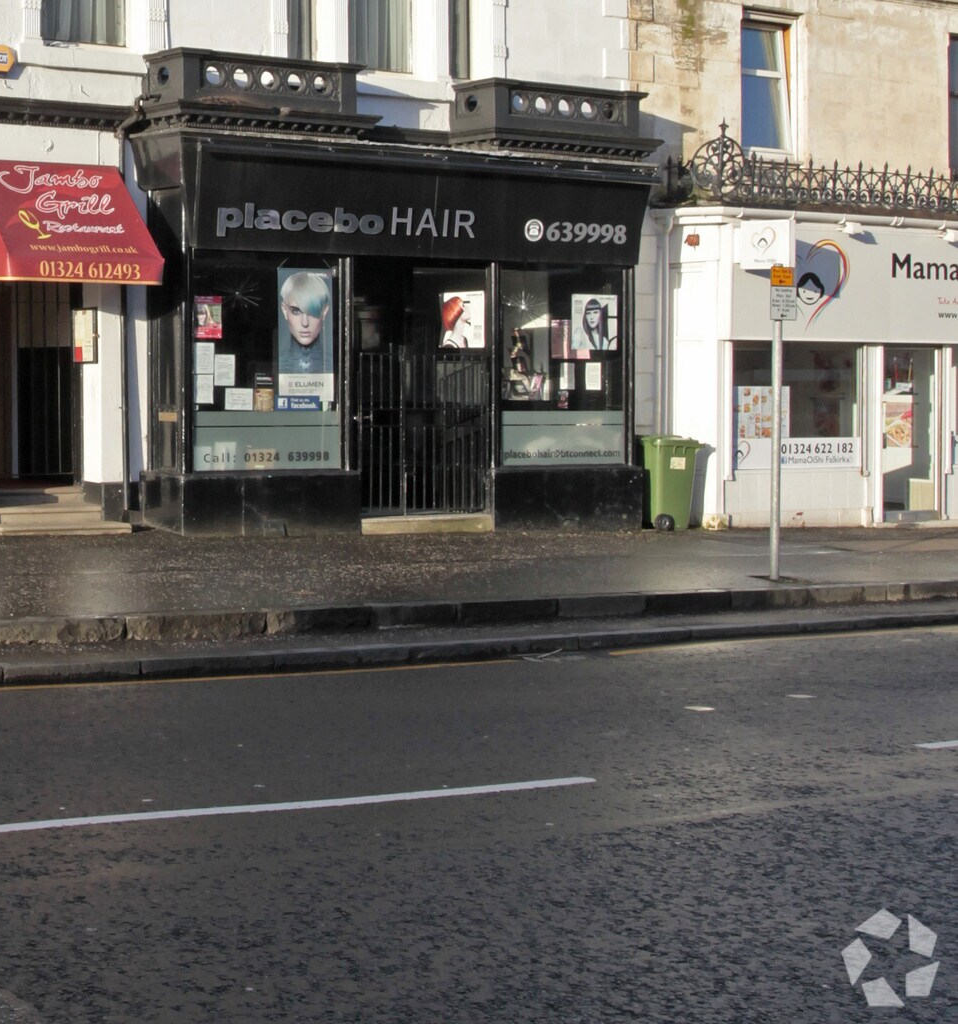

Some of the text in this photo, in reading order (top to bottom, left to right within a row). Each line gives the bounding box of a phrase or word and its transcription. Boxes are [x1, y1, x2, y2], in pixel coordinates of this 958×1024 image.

[35, 190, 115, 219] Grill
[43, 220, 125, 235] Restaurant
[216, 202, 476, 239] placebo HAIR
[546, 221, 628, 245] 639998
[29, 243, 138, 255] www.jambogrill.co.uk
[39, 260, 141, 280] 01324 612493
[891, 253, 958, 281] Mama
[203, 451, 330, 463] Call: 01324 639998
[781, 443, 853, 454] 01324 622 182
